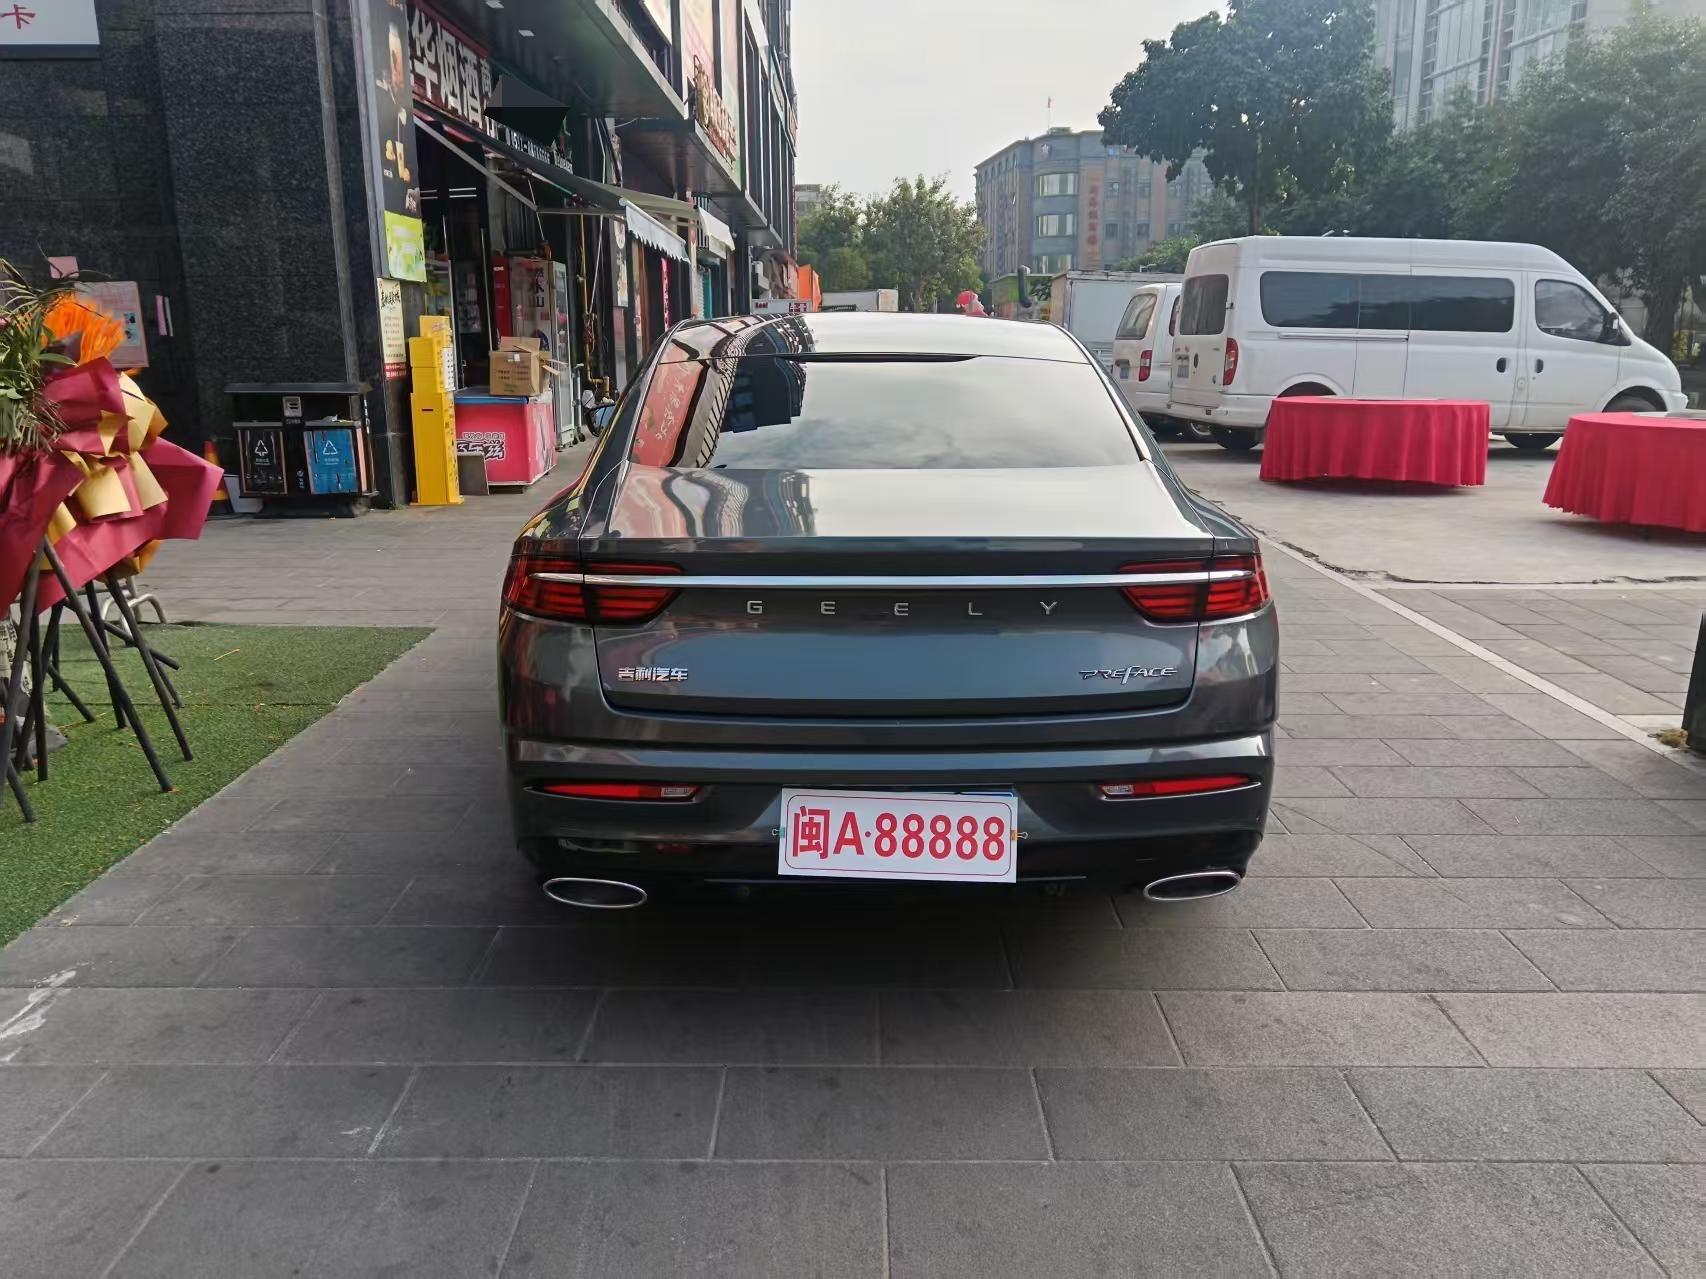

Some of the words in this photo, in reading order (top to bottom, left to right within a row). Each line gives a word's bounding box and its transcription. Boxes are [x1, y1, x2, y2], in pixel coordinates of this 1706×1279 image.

[747, 600, 1057, 616] GEELY
[618, 666, 689, 682] 吉利汽车
